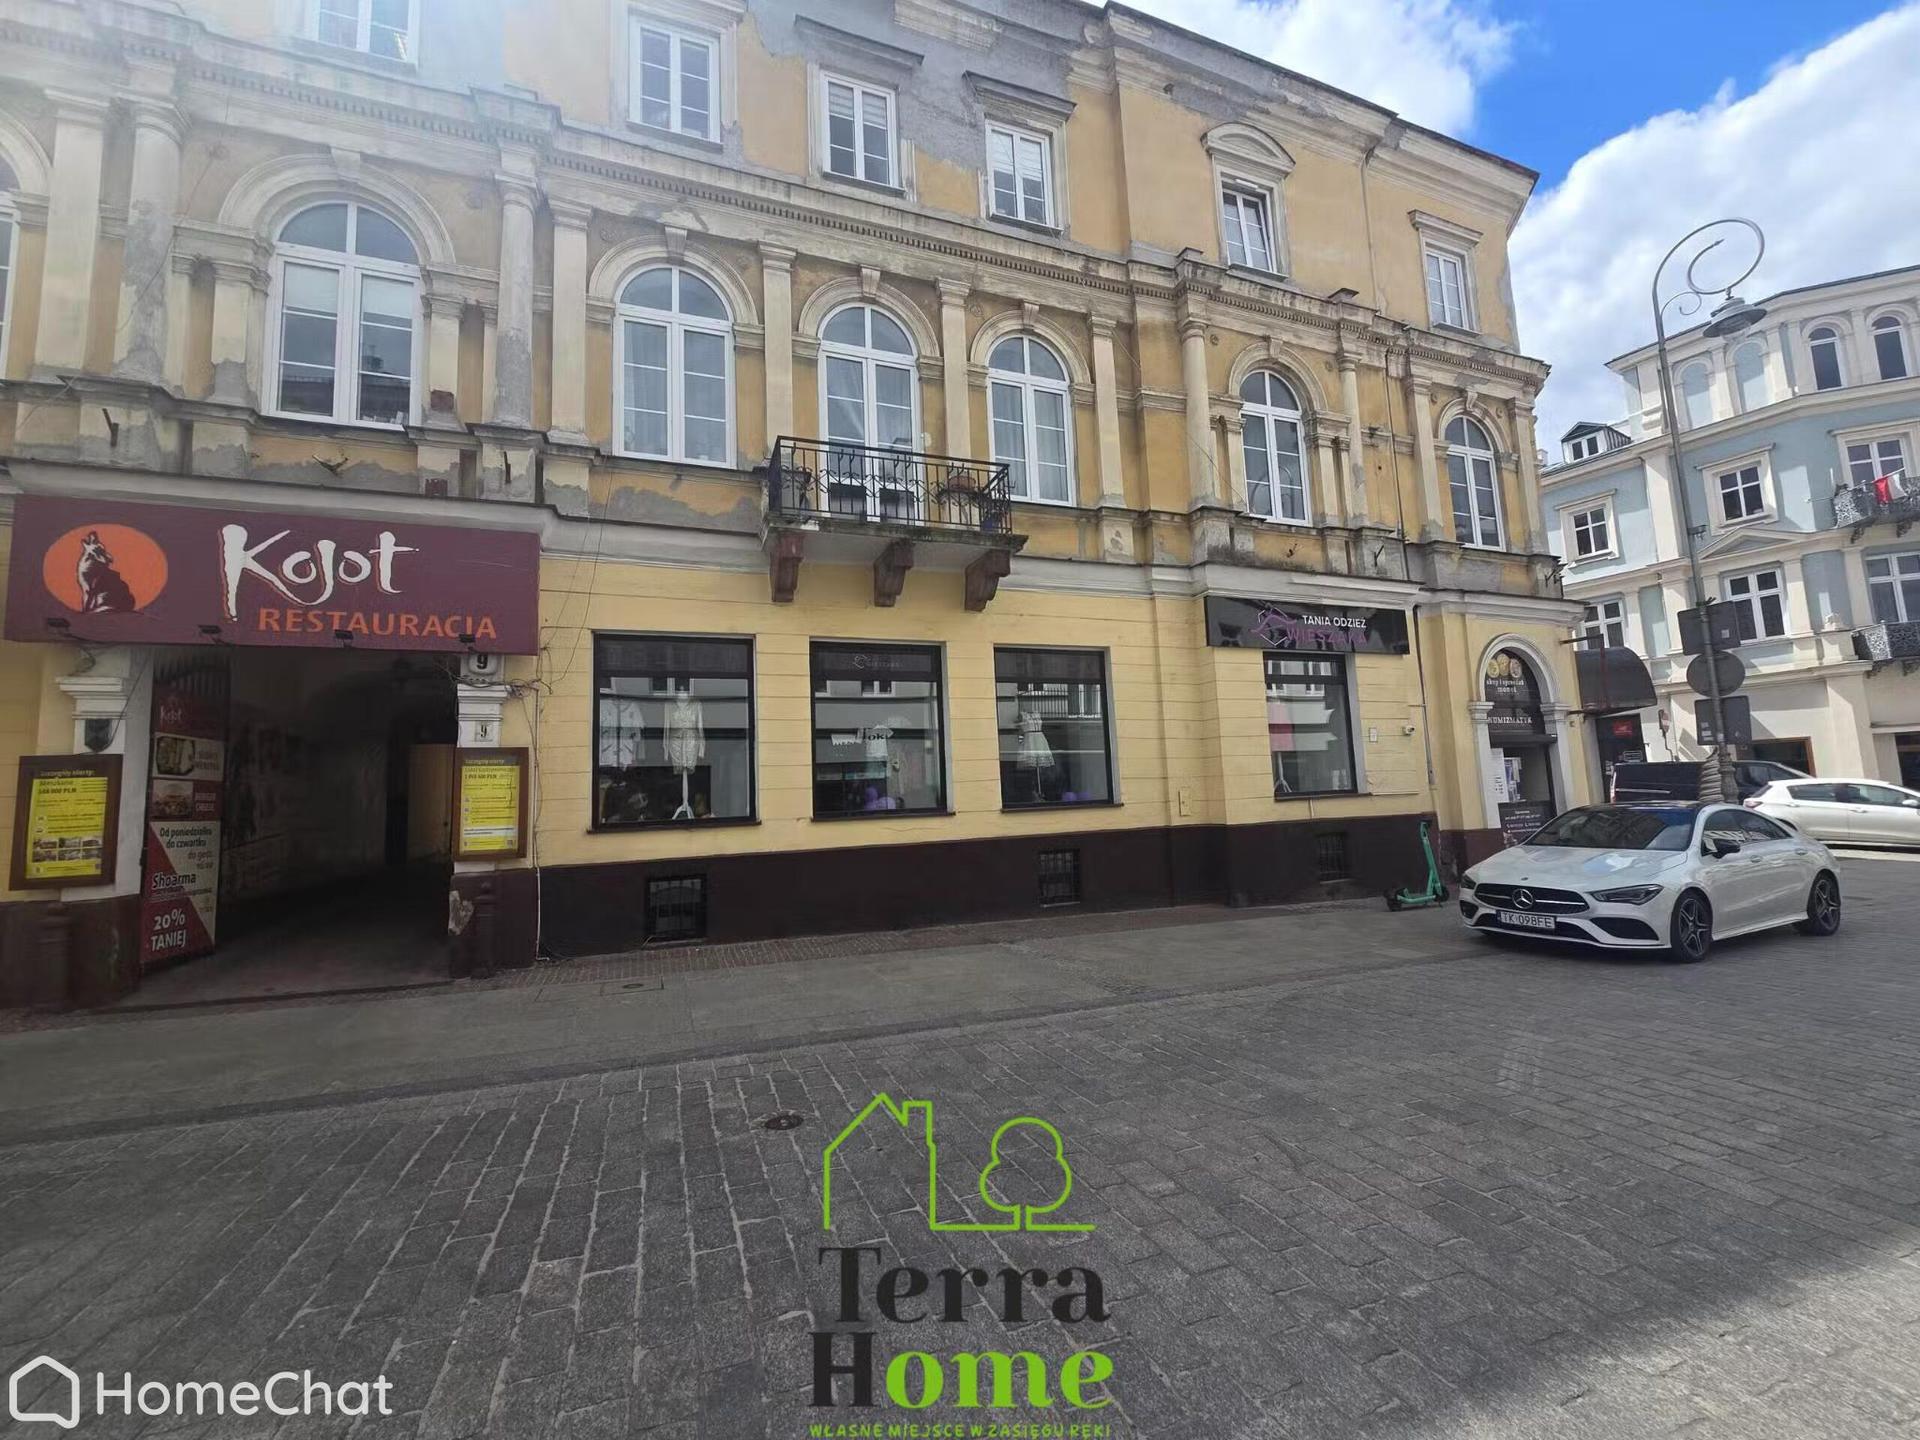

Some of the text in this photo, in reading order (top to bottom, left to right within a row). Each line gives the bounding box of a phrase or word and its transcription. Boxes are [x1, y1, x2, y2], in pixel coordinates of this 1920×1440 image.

[220, 523, 421, 622] Kojot
[1302, 614, 1331, 627] TANIA
[476, 654, 488, 670] 9
[480, 724, 488, 739] 9
[159, 827, 170, 838] Od
[166, 839, 175, 849] do
[151, 871, 197, 889] Shoarma
[153, 908, 186, 931] 20%
[1503, 912, 1553, 928] TK 098FE
[151, 930, 187, 952] TANIEJ
